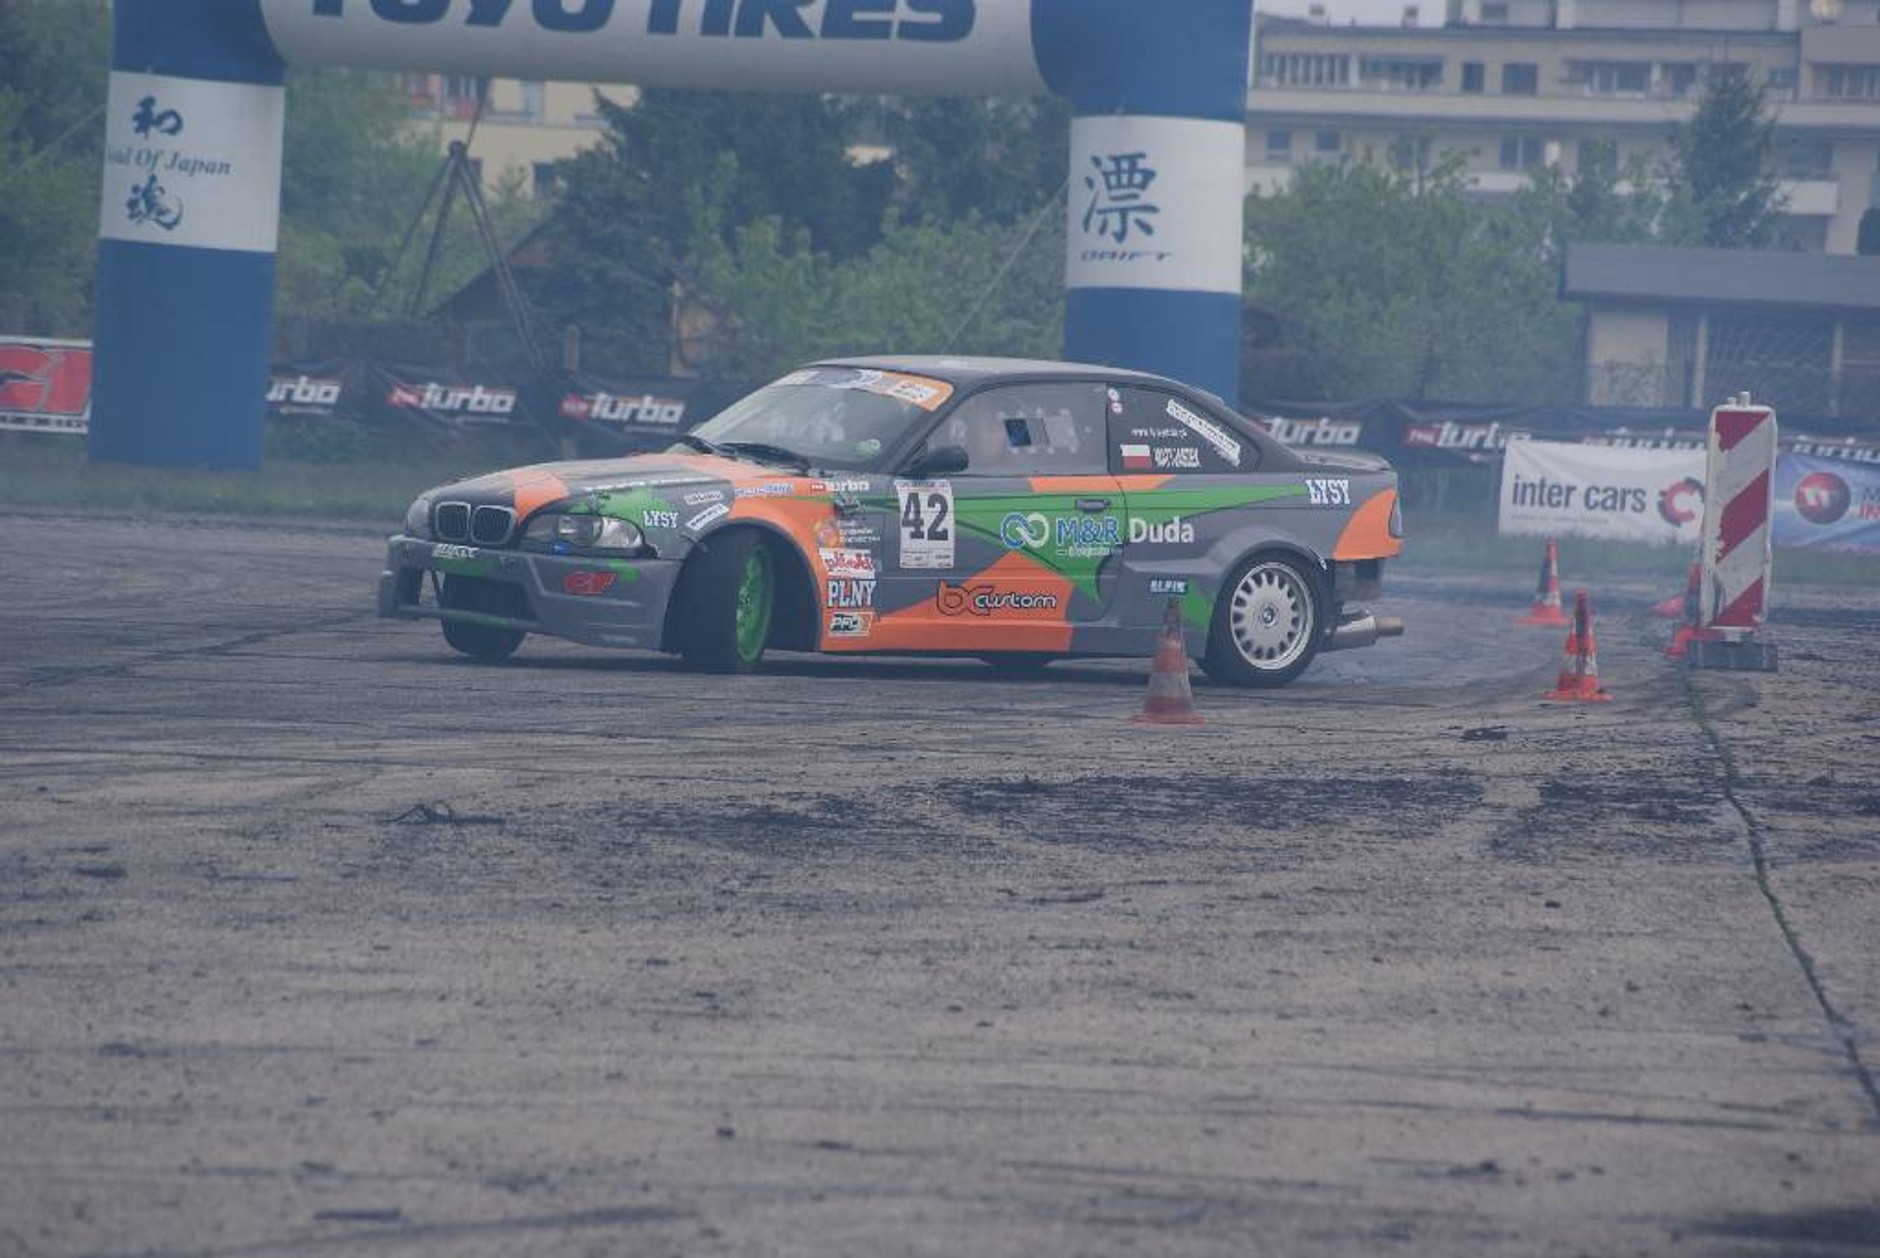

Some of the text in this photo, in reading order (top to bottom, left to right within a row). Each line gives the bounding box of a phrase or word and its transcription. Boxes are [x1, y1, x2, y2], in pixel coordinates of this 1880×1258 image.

[135, 149, 164, 174] Of
[164, 153, 232, 177] Japan
[421, 382, 516, 413] turbo
[588, 392, 685, 424] turbo
[1266, 416, 1359, 445] turbo
[1512, 474, 1646, 514] inter cars
[902, 492, 949, 541] 42
[1056, 516, 1195, 546] M&R Duda
[827, 580, 876, 607] PLNY
